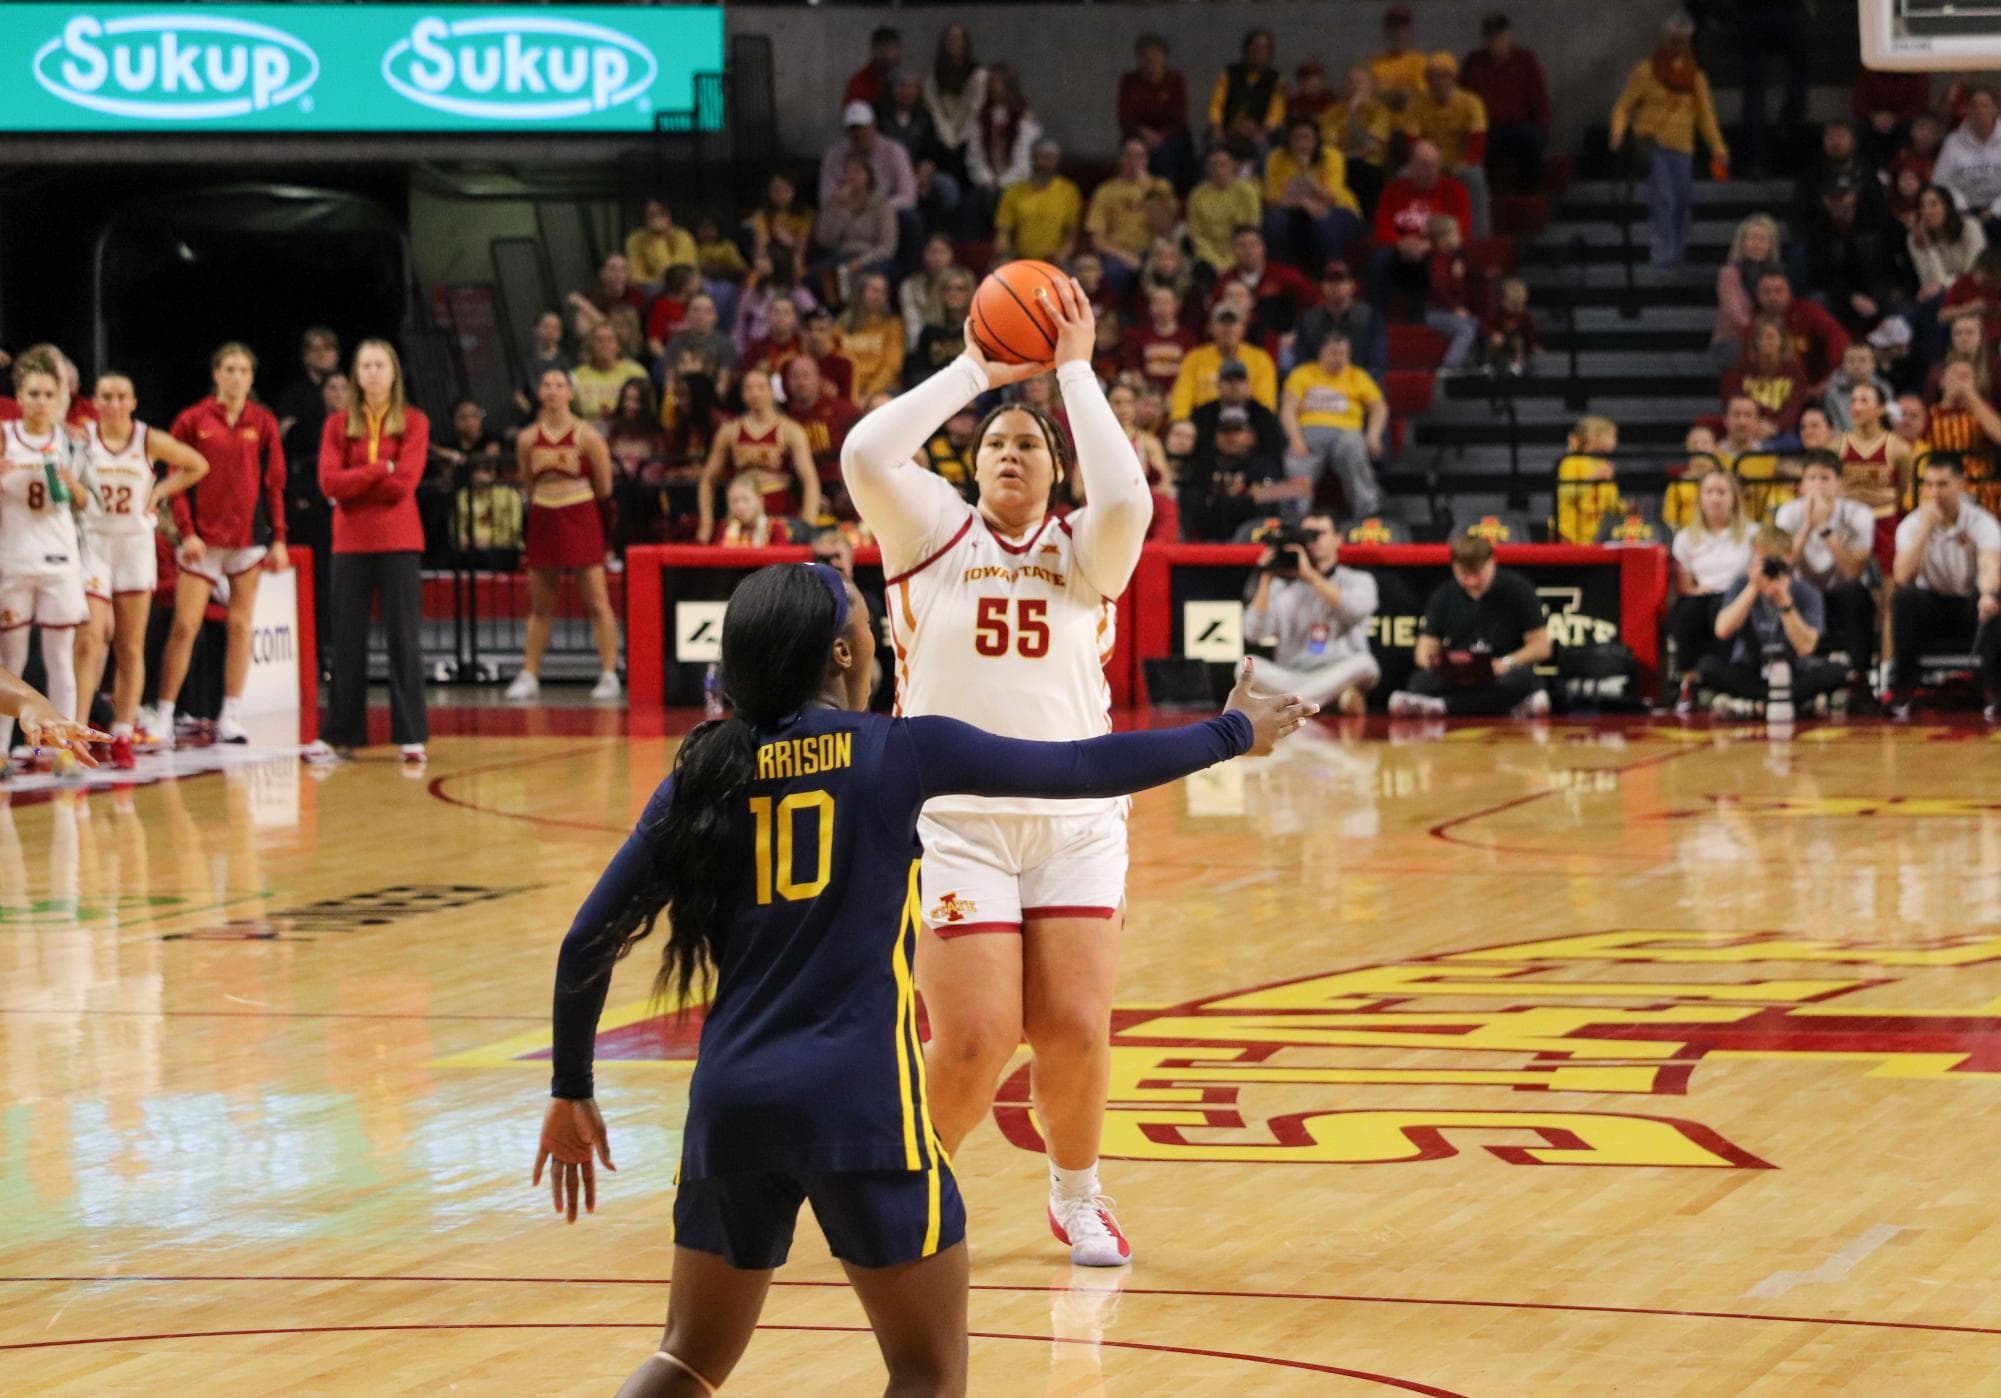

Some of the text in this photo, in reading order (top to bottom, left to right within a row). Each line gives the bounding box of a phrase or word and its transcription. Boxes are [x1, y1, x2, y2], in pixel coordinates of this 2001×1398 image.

[61, 15, 291, 111] Sukup
[408, 16, 630, 111] Sukup
[28, 482, 44, 511] 8
[99, 484, 132, 514] 22
[964, 565, 1010, 583] IOWA
[975, 597, 1050, 659] 55
[1366, 616, 1428, 647] FIE
[756, 732, 853, 780] RRISON
[749, 789, 835, 905] 10
